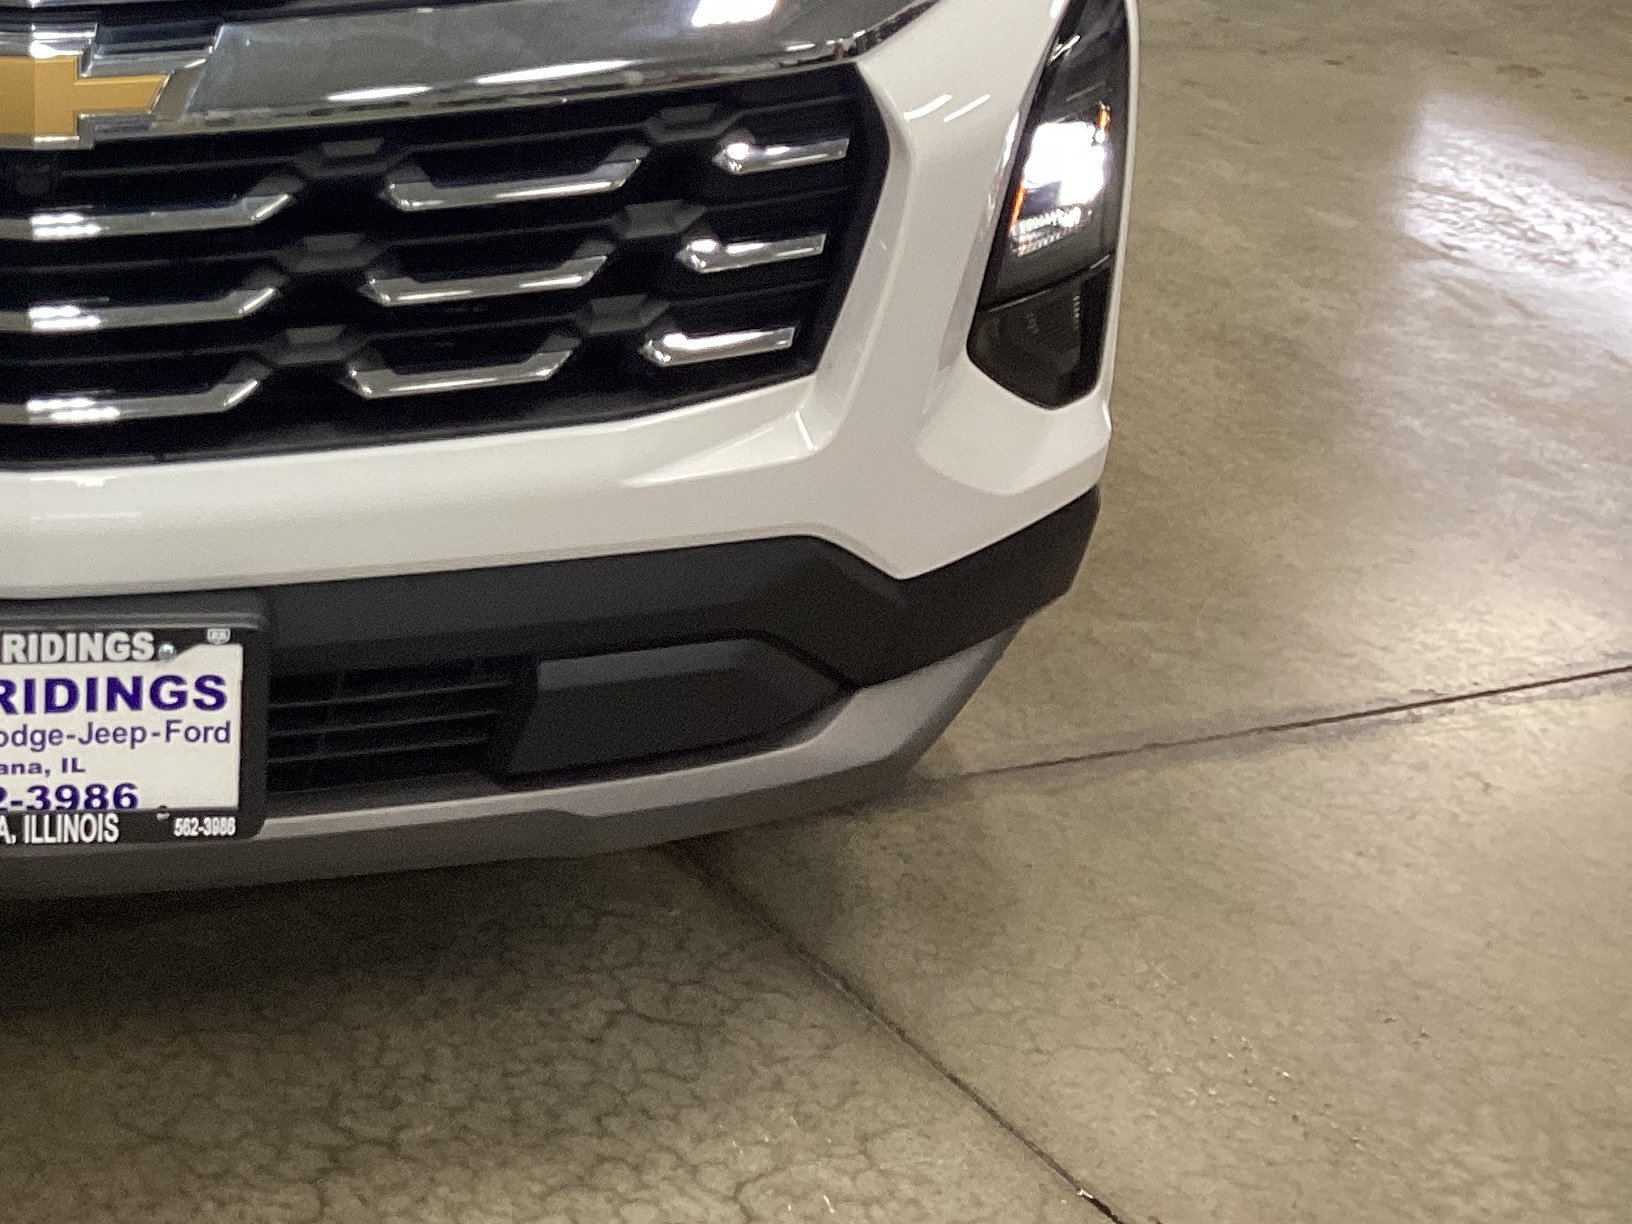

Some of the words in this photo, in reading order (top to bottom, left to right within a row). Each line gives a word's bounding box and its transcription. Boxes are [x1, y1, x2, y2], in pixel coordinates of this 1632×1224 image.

[2, 631, 154, 664] RIDINGS
[61, 758, 86, 774] IL
[23, 812, 120, 844] ILLINOIS
